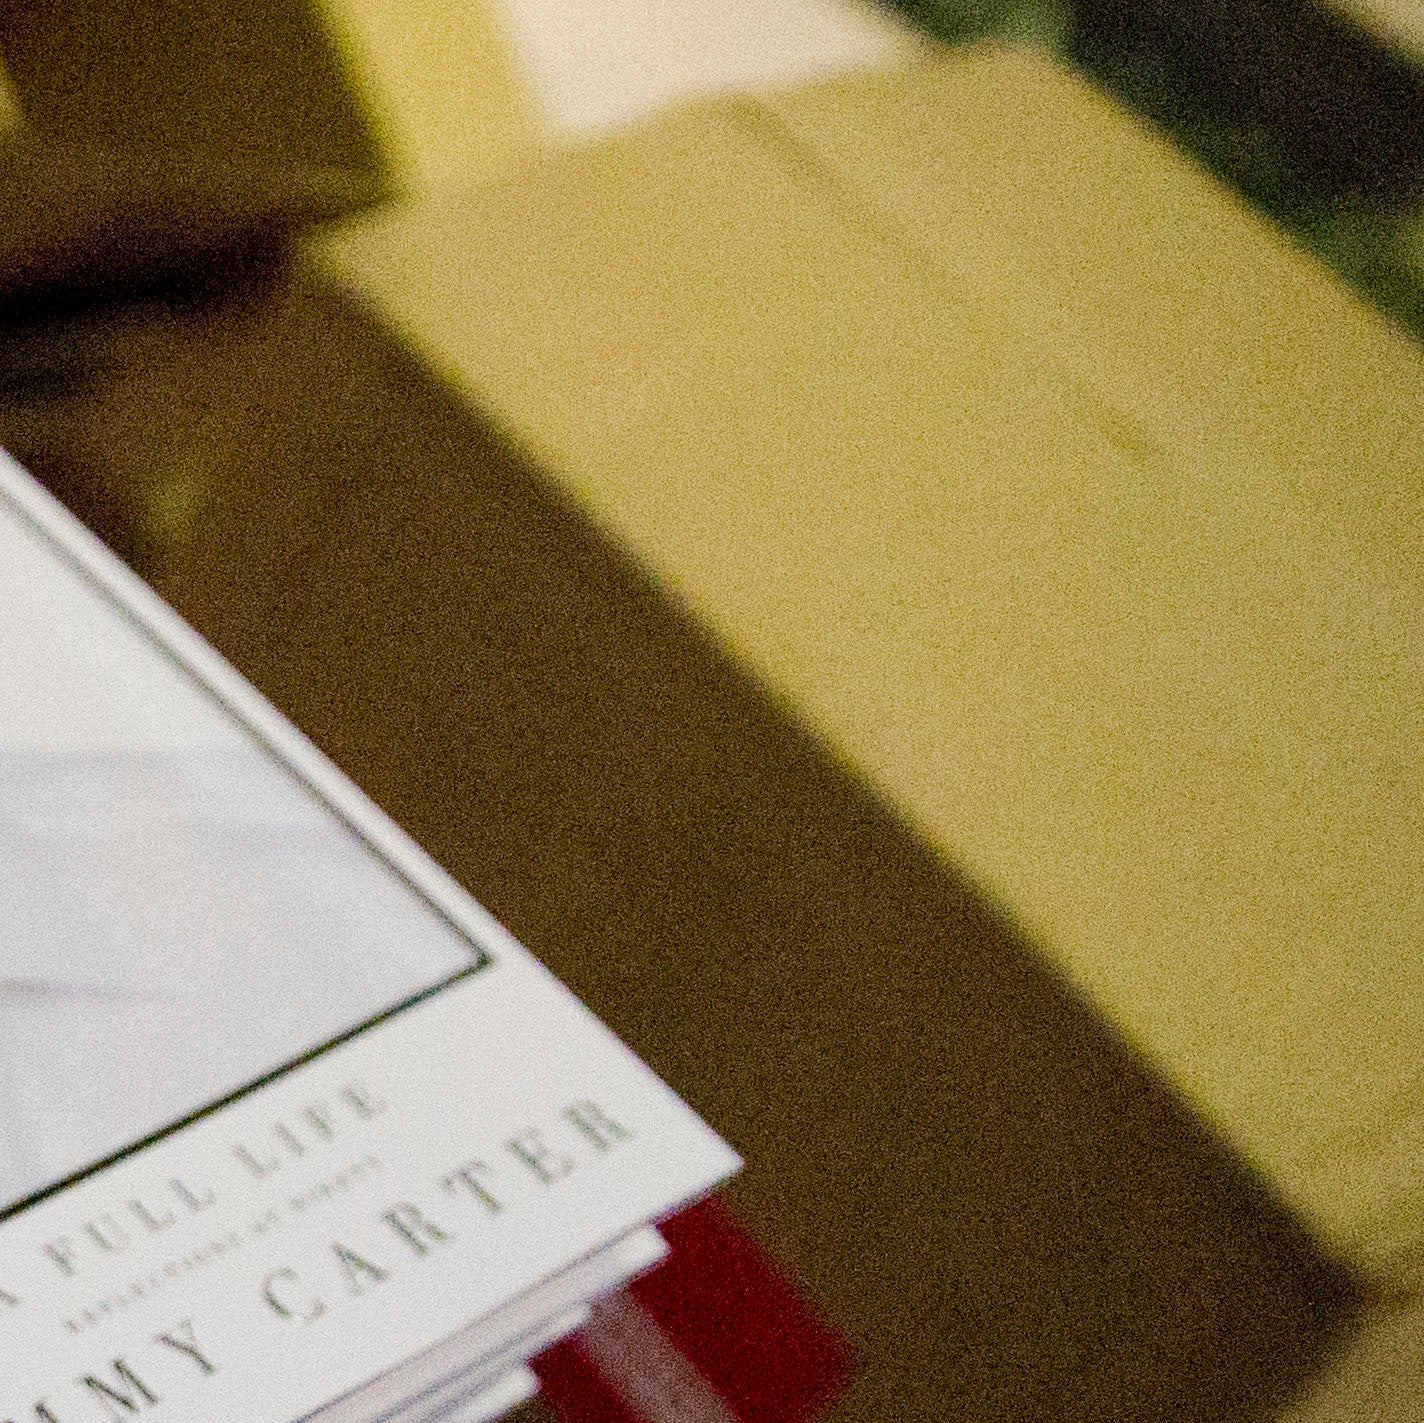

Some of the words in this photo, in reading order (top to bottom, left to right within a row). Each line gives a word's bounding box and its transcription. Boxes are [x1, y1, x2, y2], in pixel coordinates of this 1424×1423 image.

[41, 1177, 220, 1277] FULL
[230, 1077, 392, 1179] LIFE
[259, 1094, 638, 1327] CARTER
